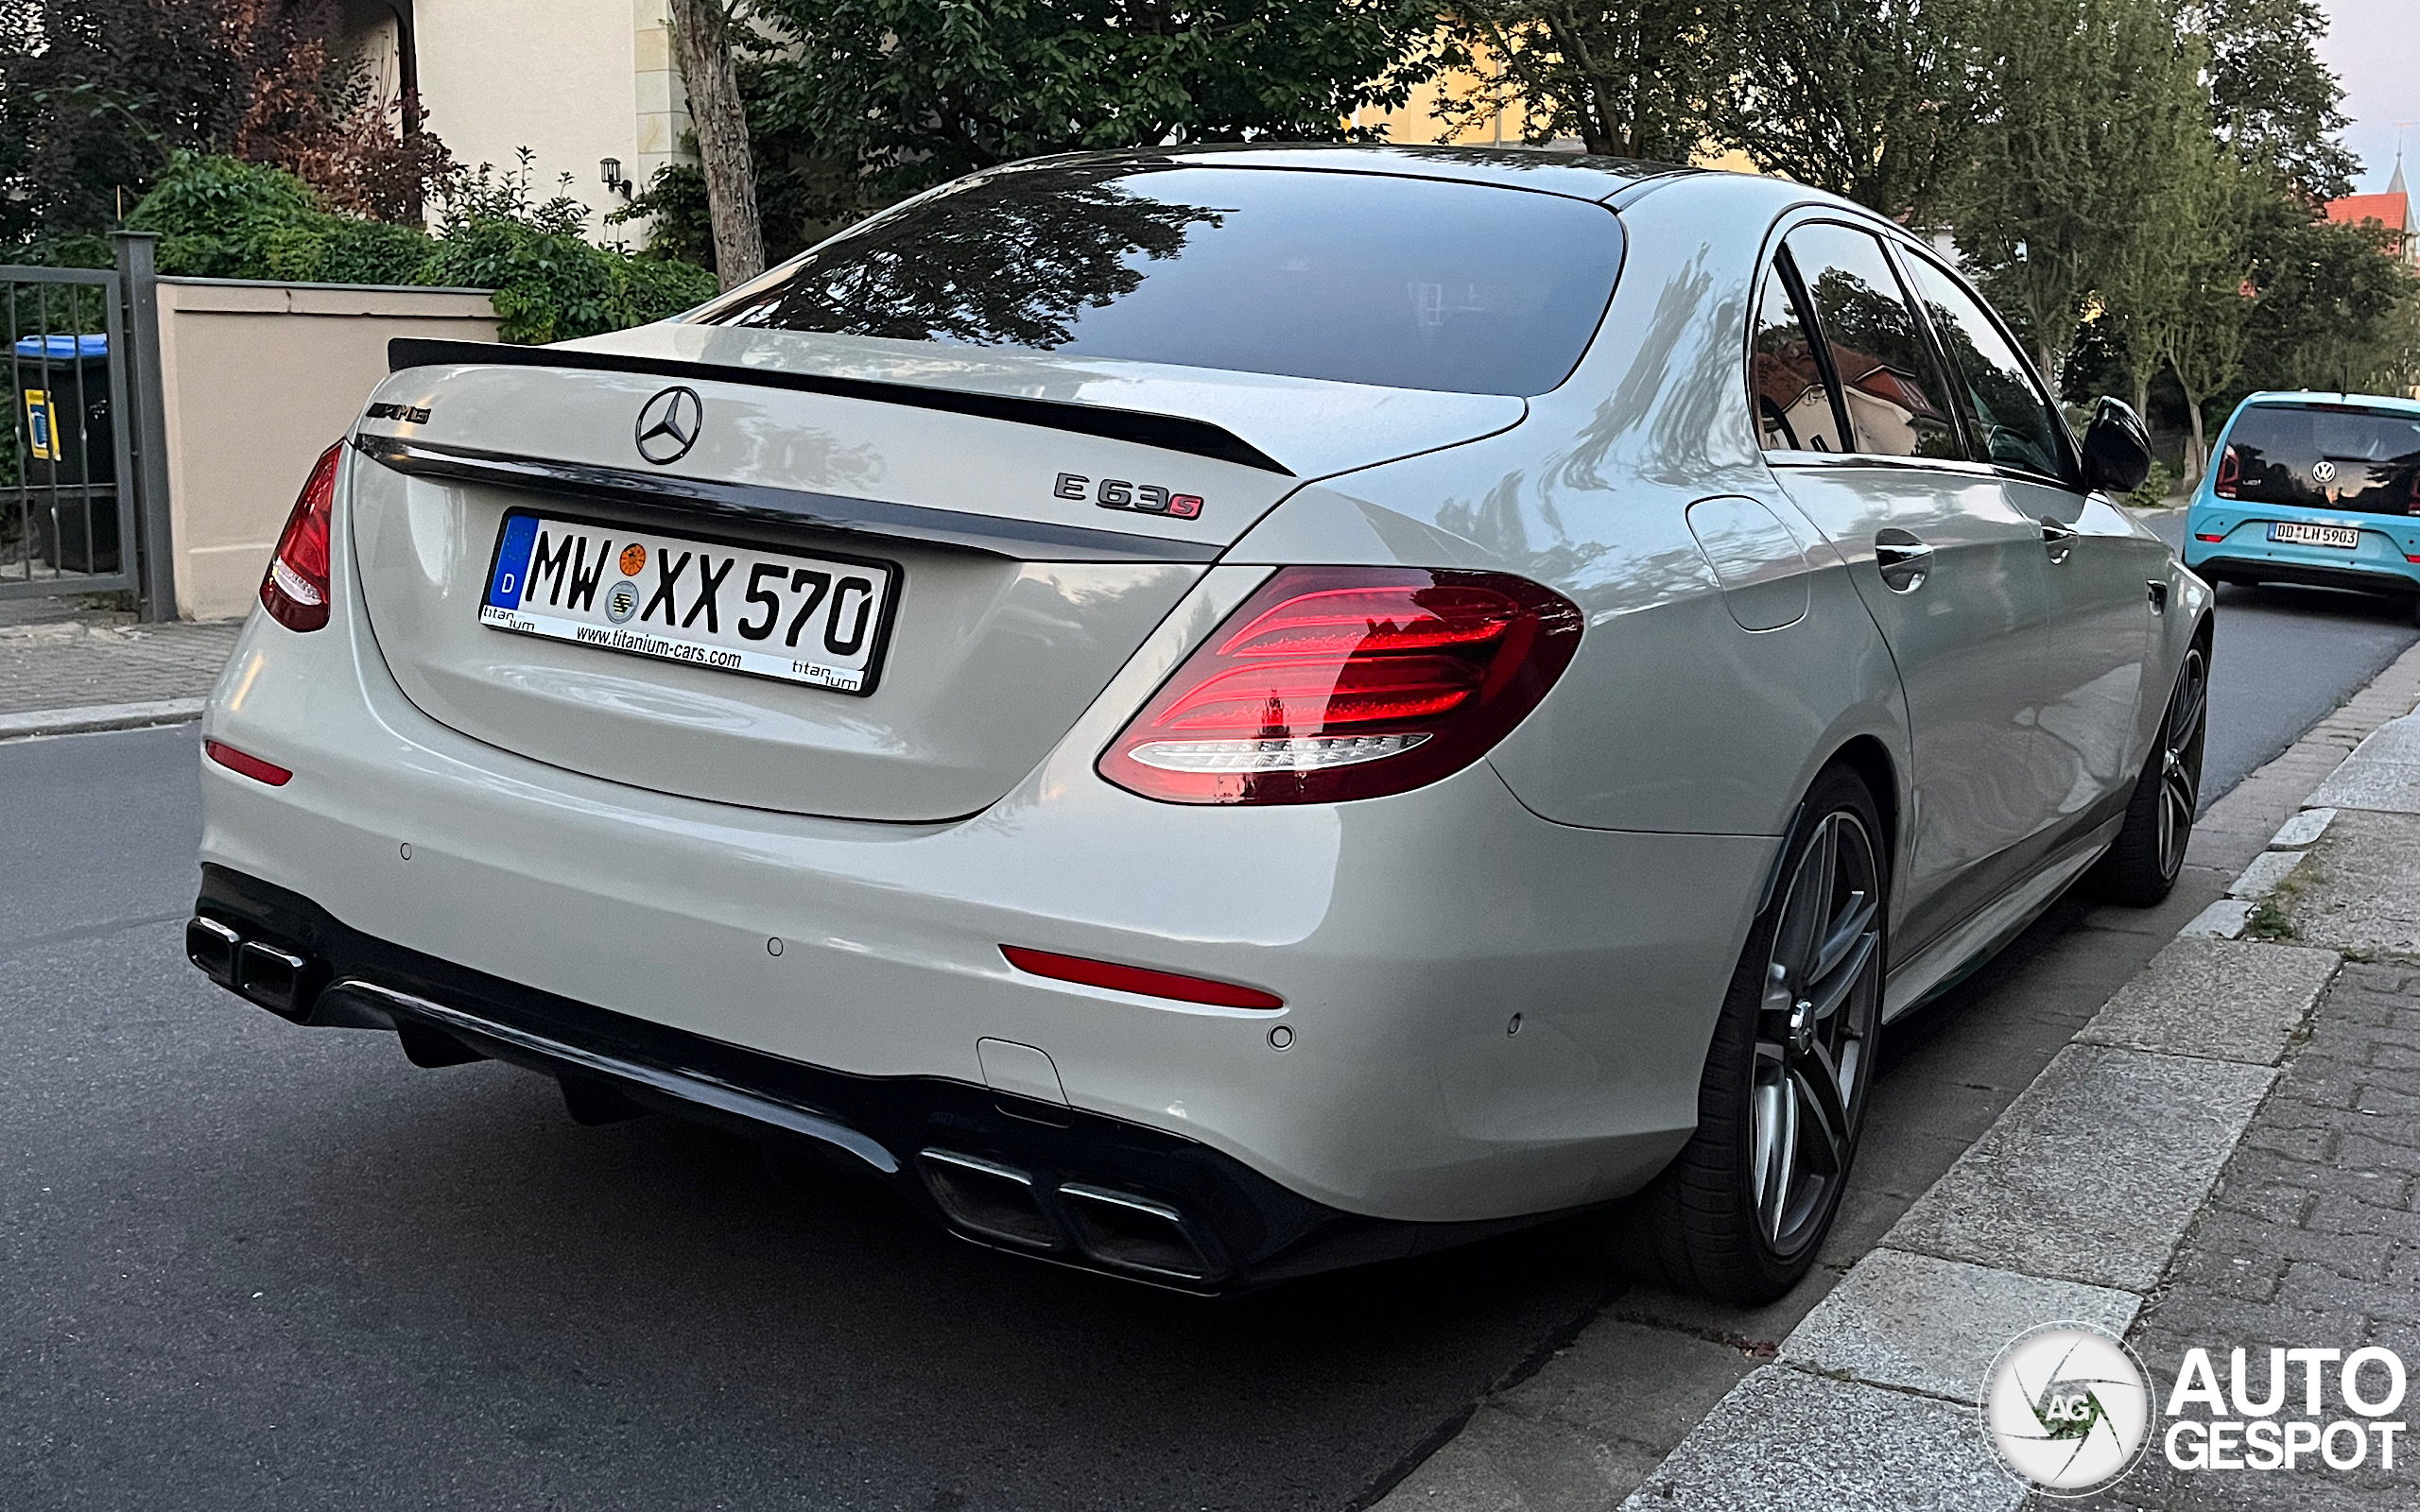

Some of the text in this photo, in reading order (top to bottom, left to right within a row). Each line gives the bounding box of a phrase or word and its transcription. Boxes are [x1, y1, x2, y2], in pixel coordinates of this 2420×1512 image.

[1054, 472, 1090, 500] E
[2277, 524, 2294, 538] DD
[2303, 527, 2321, 541] LH
[2322, 529, 2356, 544] 5903
[501, 573, 515, 593] D
[525, 530, 873, 657] MW XX 570
[576, 625, 742, 669] www.titanium-cars.com
